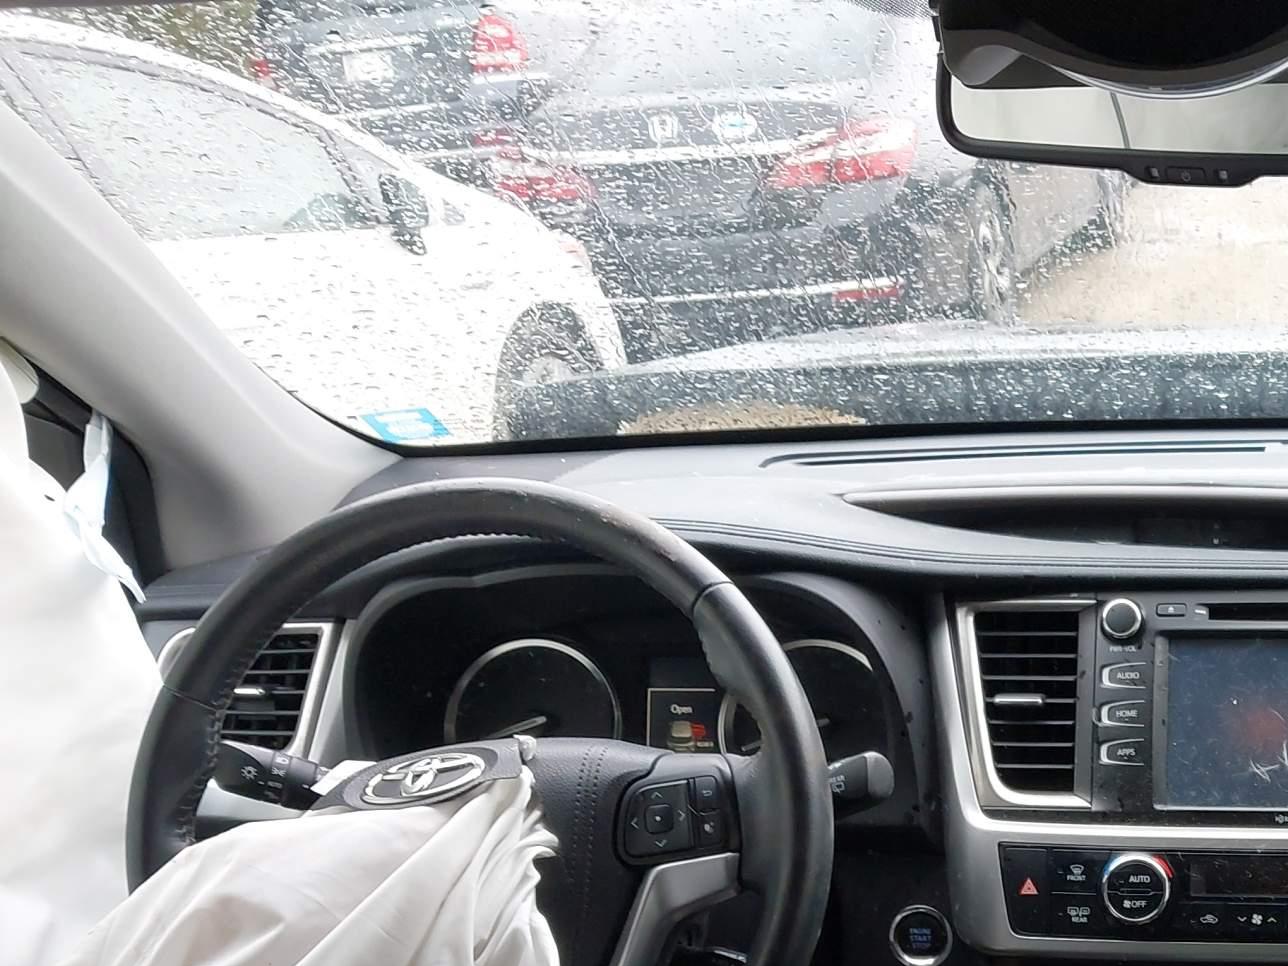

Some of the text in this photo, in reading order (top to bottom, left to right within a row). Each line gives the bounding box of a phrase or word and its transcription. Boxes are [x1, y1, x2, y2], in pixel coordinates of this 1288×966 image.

[1116, 671, 1140, 680] AUDIO
[670, 703, 694, 715] Open
[1115, 709, 1138, 718] HOME
[1116, 748, 1136, 756] APPS
[1129, 875, 1151, 883] AUTO
[1131, 900, 1147, 908] OFF
